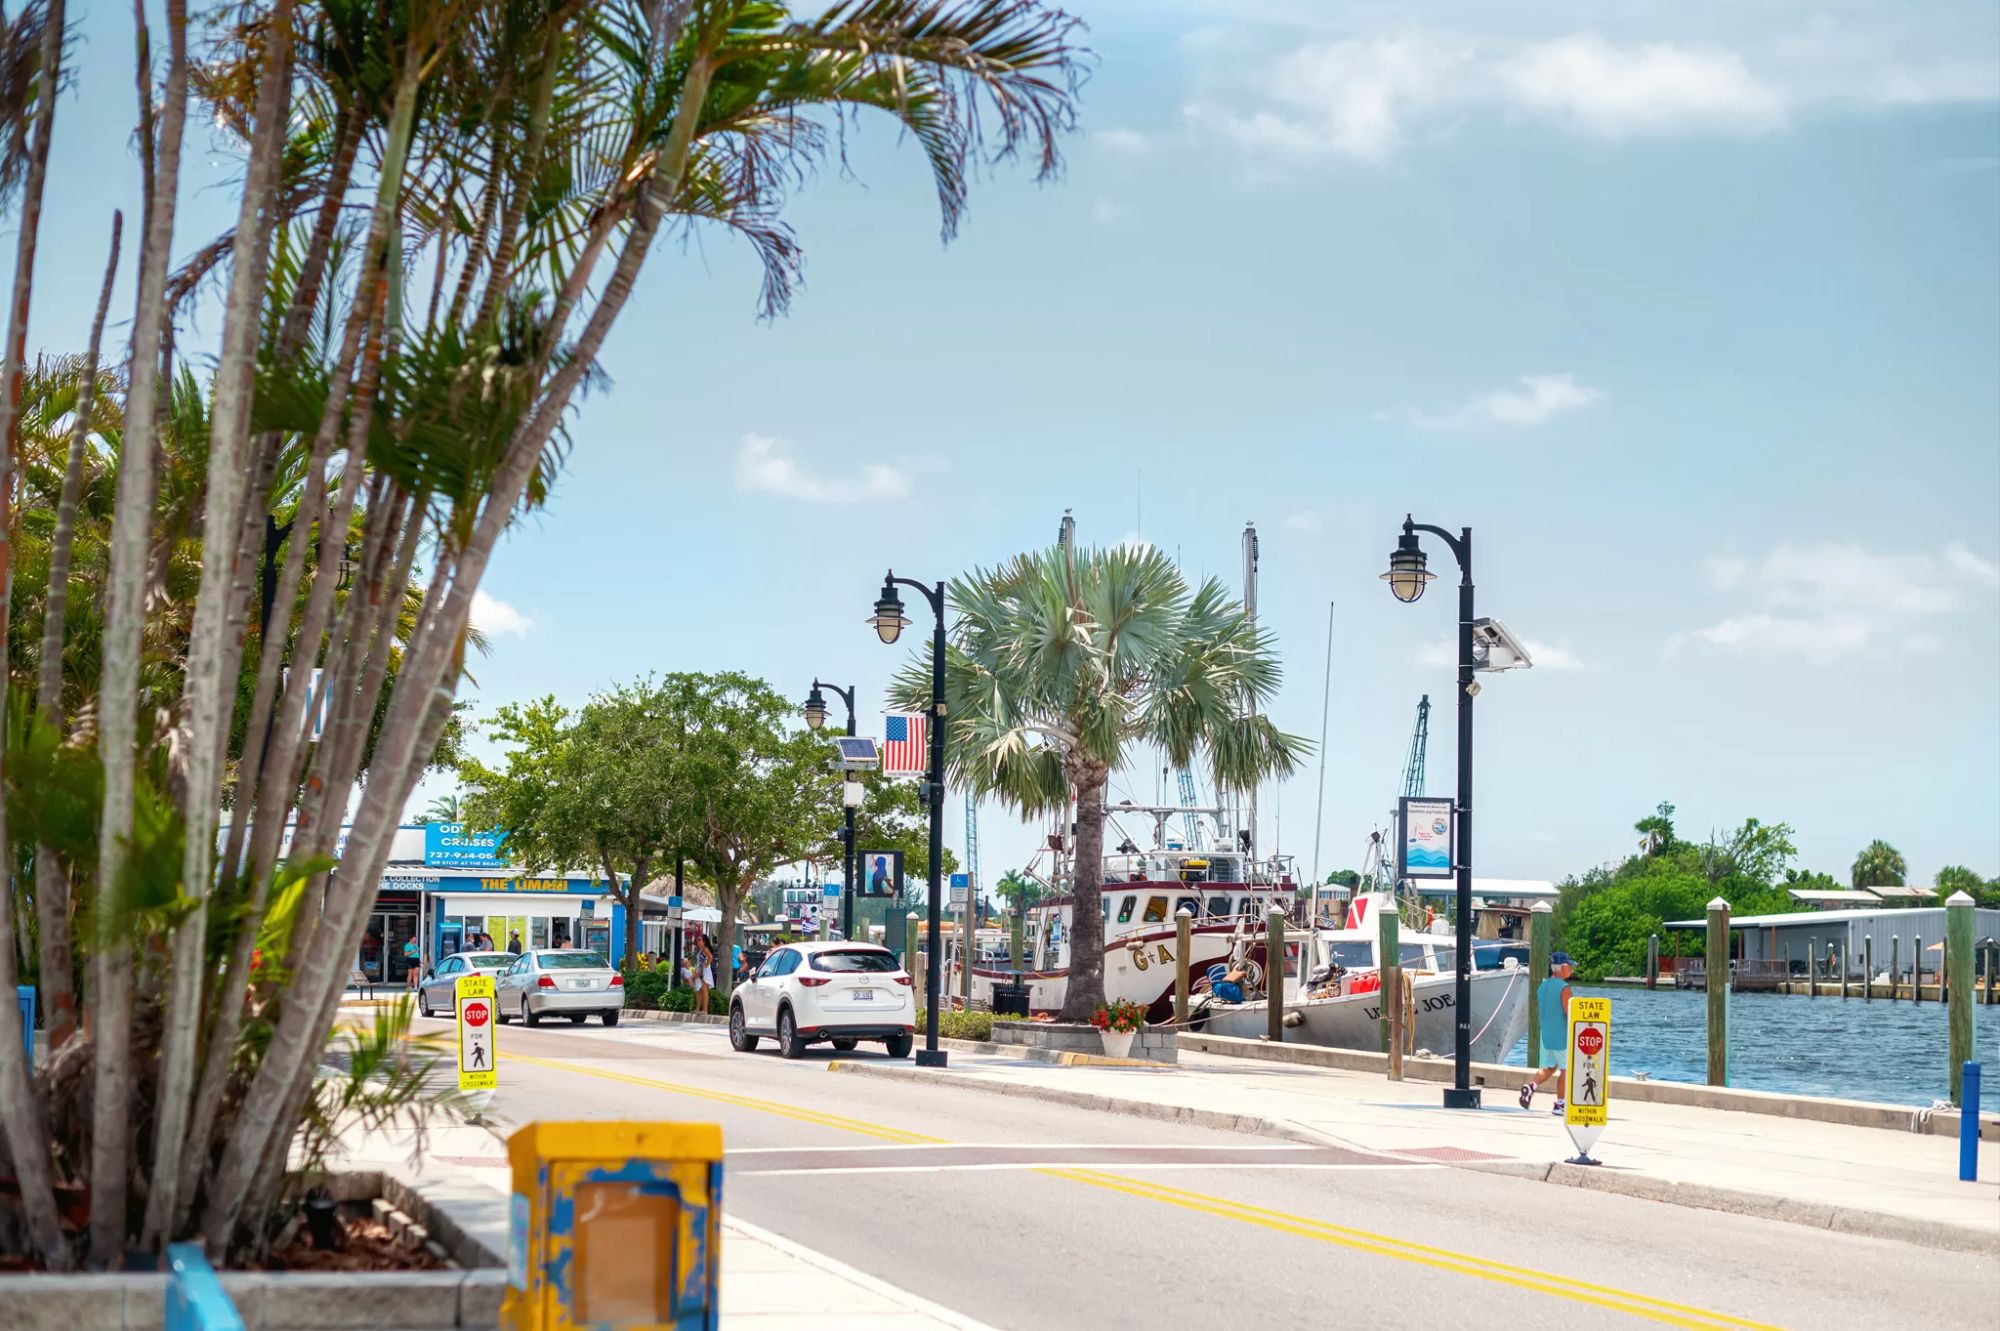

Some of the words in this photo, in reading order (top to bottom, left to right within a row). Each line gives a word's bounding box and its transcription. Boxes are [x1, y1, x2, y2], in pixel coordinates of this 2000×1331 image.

[393, 882, 425, 890] DOCKS
[480, 878, 508, 890] THE
[463, 979, 488, 988] STATE
[468, 988, 484, 996] LAW
[1422, 993, 1457, 1013] JOE
[1578, 1001, 1605, 1011] STATE
[465, 1010, 488, 1020] STOP
[1582, 1011, 1600, 1020] LAW
[1578, 1035, 1602, 1047] STOP
